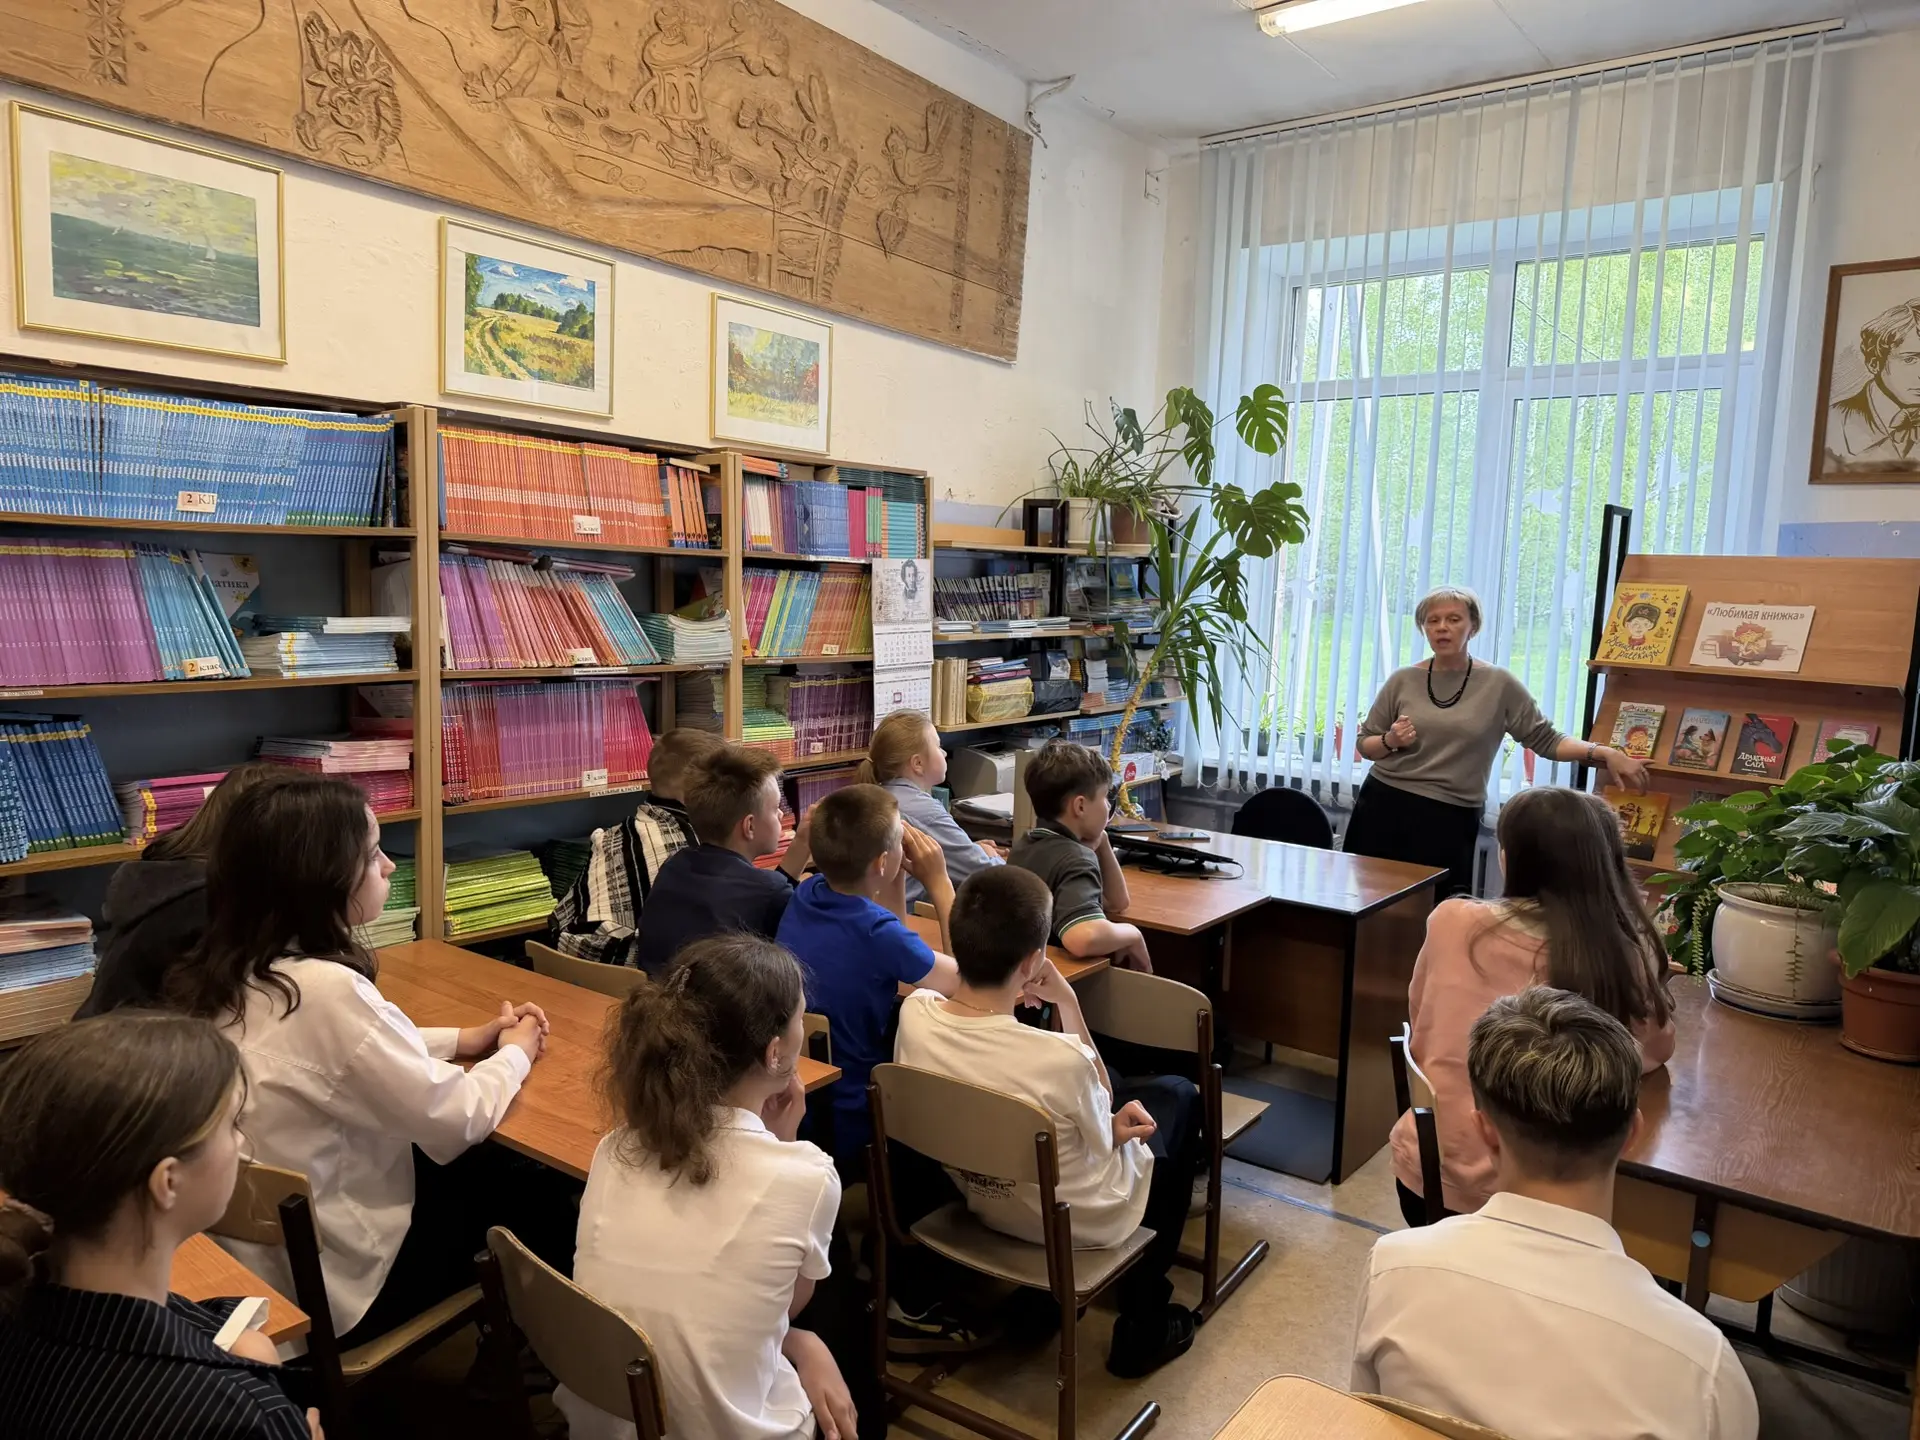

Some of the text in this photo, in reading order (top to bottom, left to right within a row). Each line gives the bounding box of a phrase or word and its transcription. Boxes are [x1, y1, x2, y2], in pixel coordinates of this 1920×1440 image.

[187, 493, 215, 505] 2 КЛ
[1707, 606, 1805, 621] «Любимая книжка»
[188, 663, 195, 672] 2
[1737, 752, 1777, 763] ДРАКОНЬЯ
[1744, 760, 1766, 769] САГА
